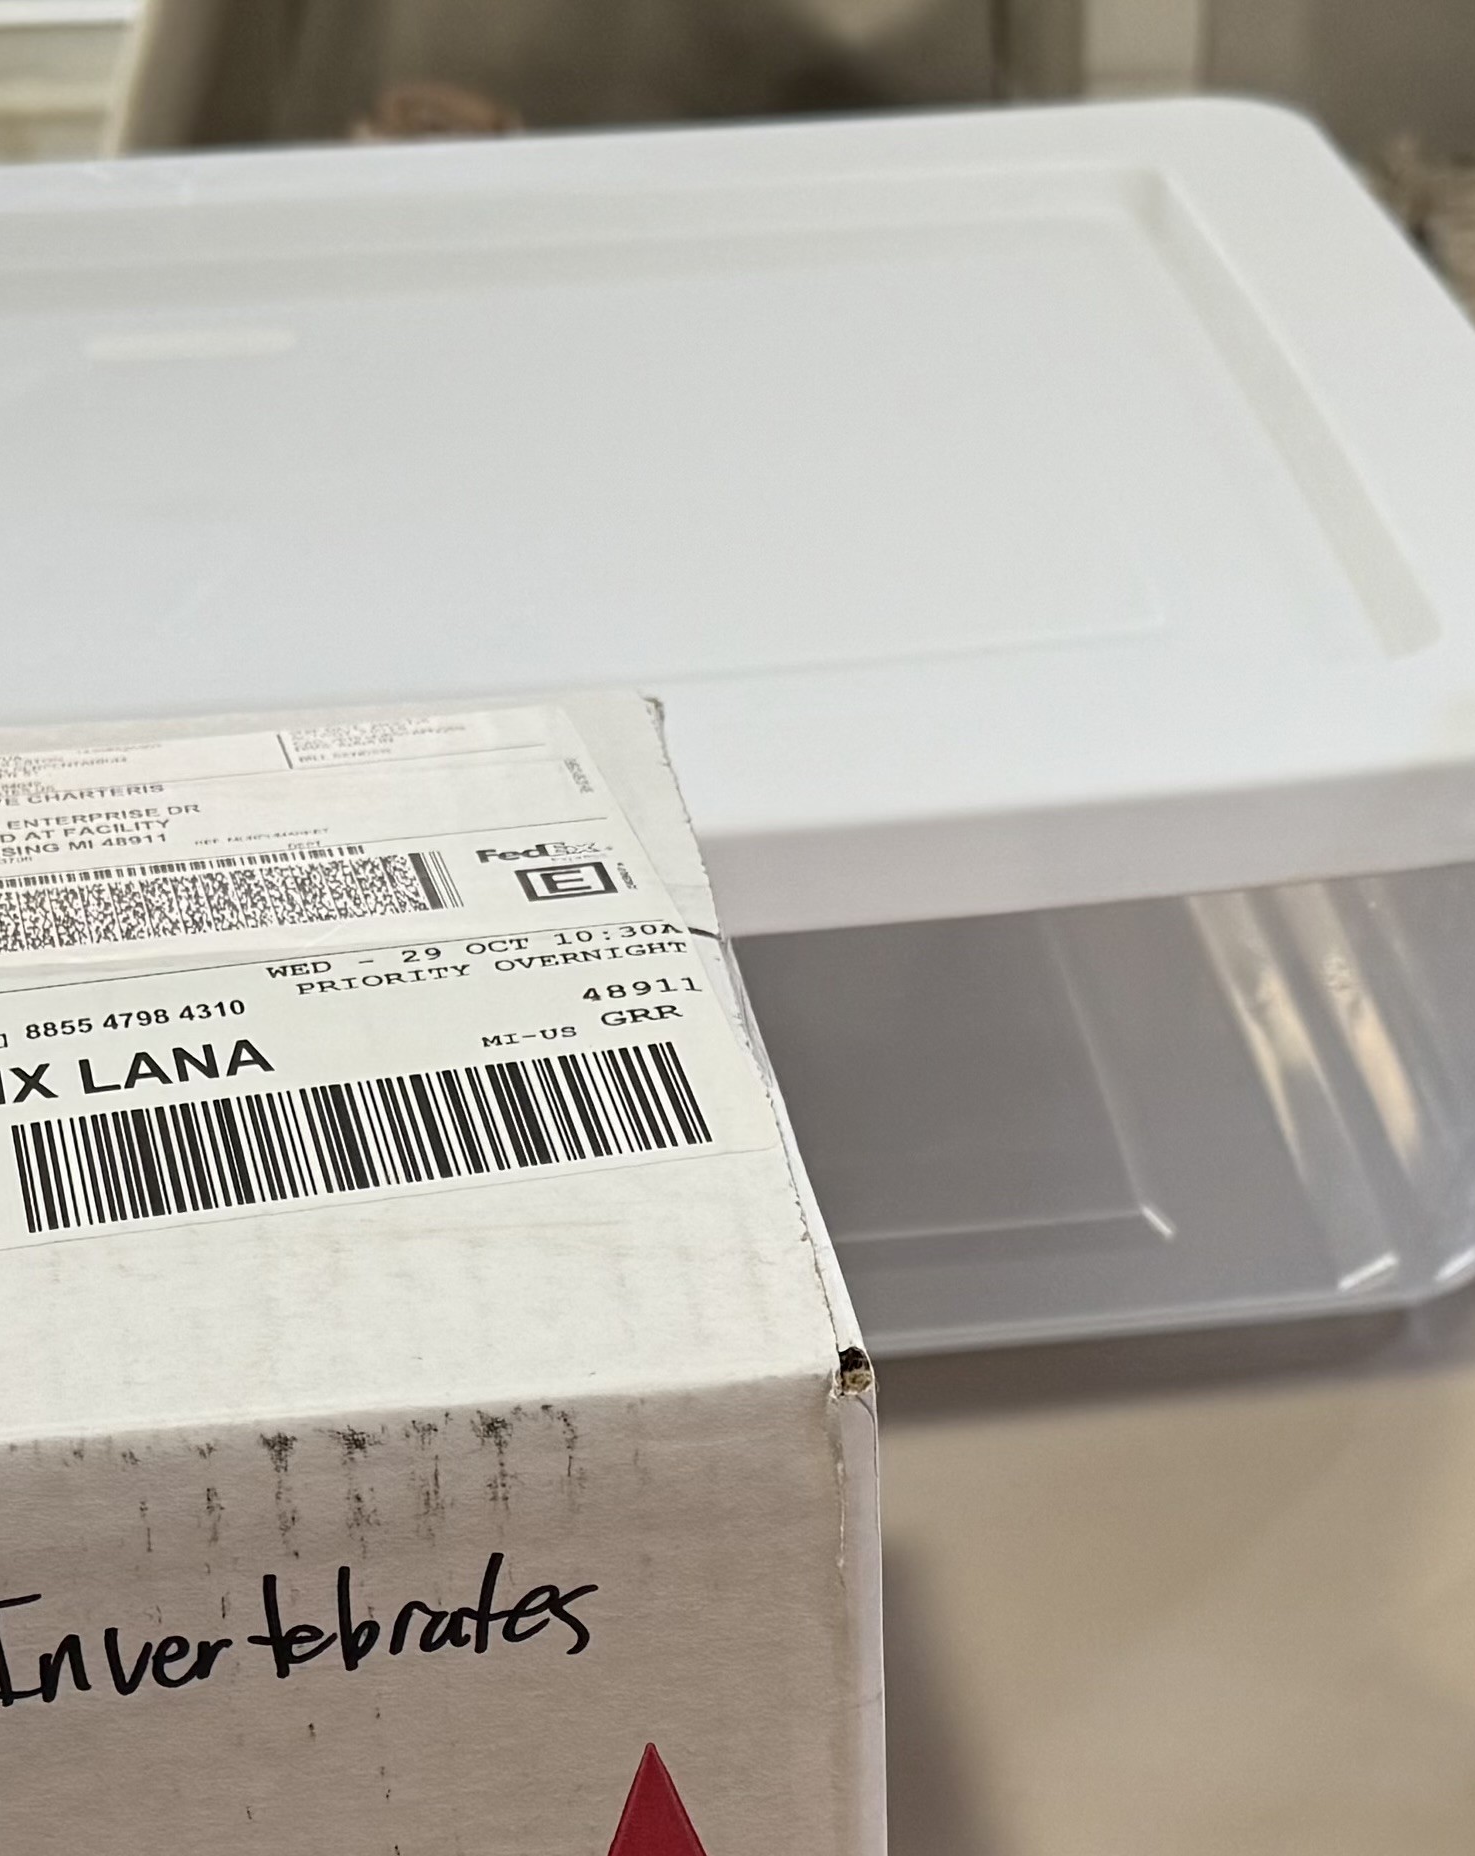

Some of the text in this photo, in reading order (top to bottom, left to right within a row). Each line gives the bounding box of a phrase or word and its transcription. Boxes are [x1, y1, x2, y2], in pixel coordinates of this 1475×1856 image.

[27, 784, 166, 805] CHARTERIS
[6, 808, 162, 830] ENTERPRISE
[168, 804, 201, 816] DR
[24, 830, 55, 842] AT
[63, 819, 170, 838] FACILITY
[68, 839, 93, 851] MI
[101, 833, 167, 847] 48911
[476, 842, 601, 863] FedEx
[540, 869, 592, 894] E
[267, 960, 332, 980] WED
[402, 947, 442, 964] 29
[466, 938, 529, 956] OCT
[554, 923, 684, 946] 10:30A
[296, 941, 689, 996] PRIORITY OVERNIGHT
[582, 976, 703, 1003] 48911
[25, 1016, 93, 1040] 8855
[103, 1007, 170, 1030] 4798
[179, 998, 246, 1022] 4310
[482, 1004, 683, 1048] MI-US GRR
[78, 1039, 276, 1094] LANA
